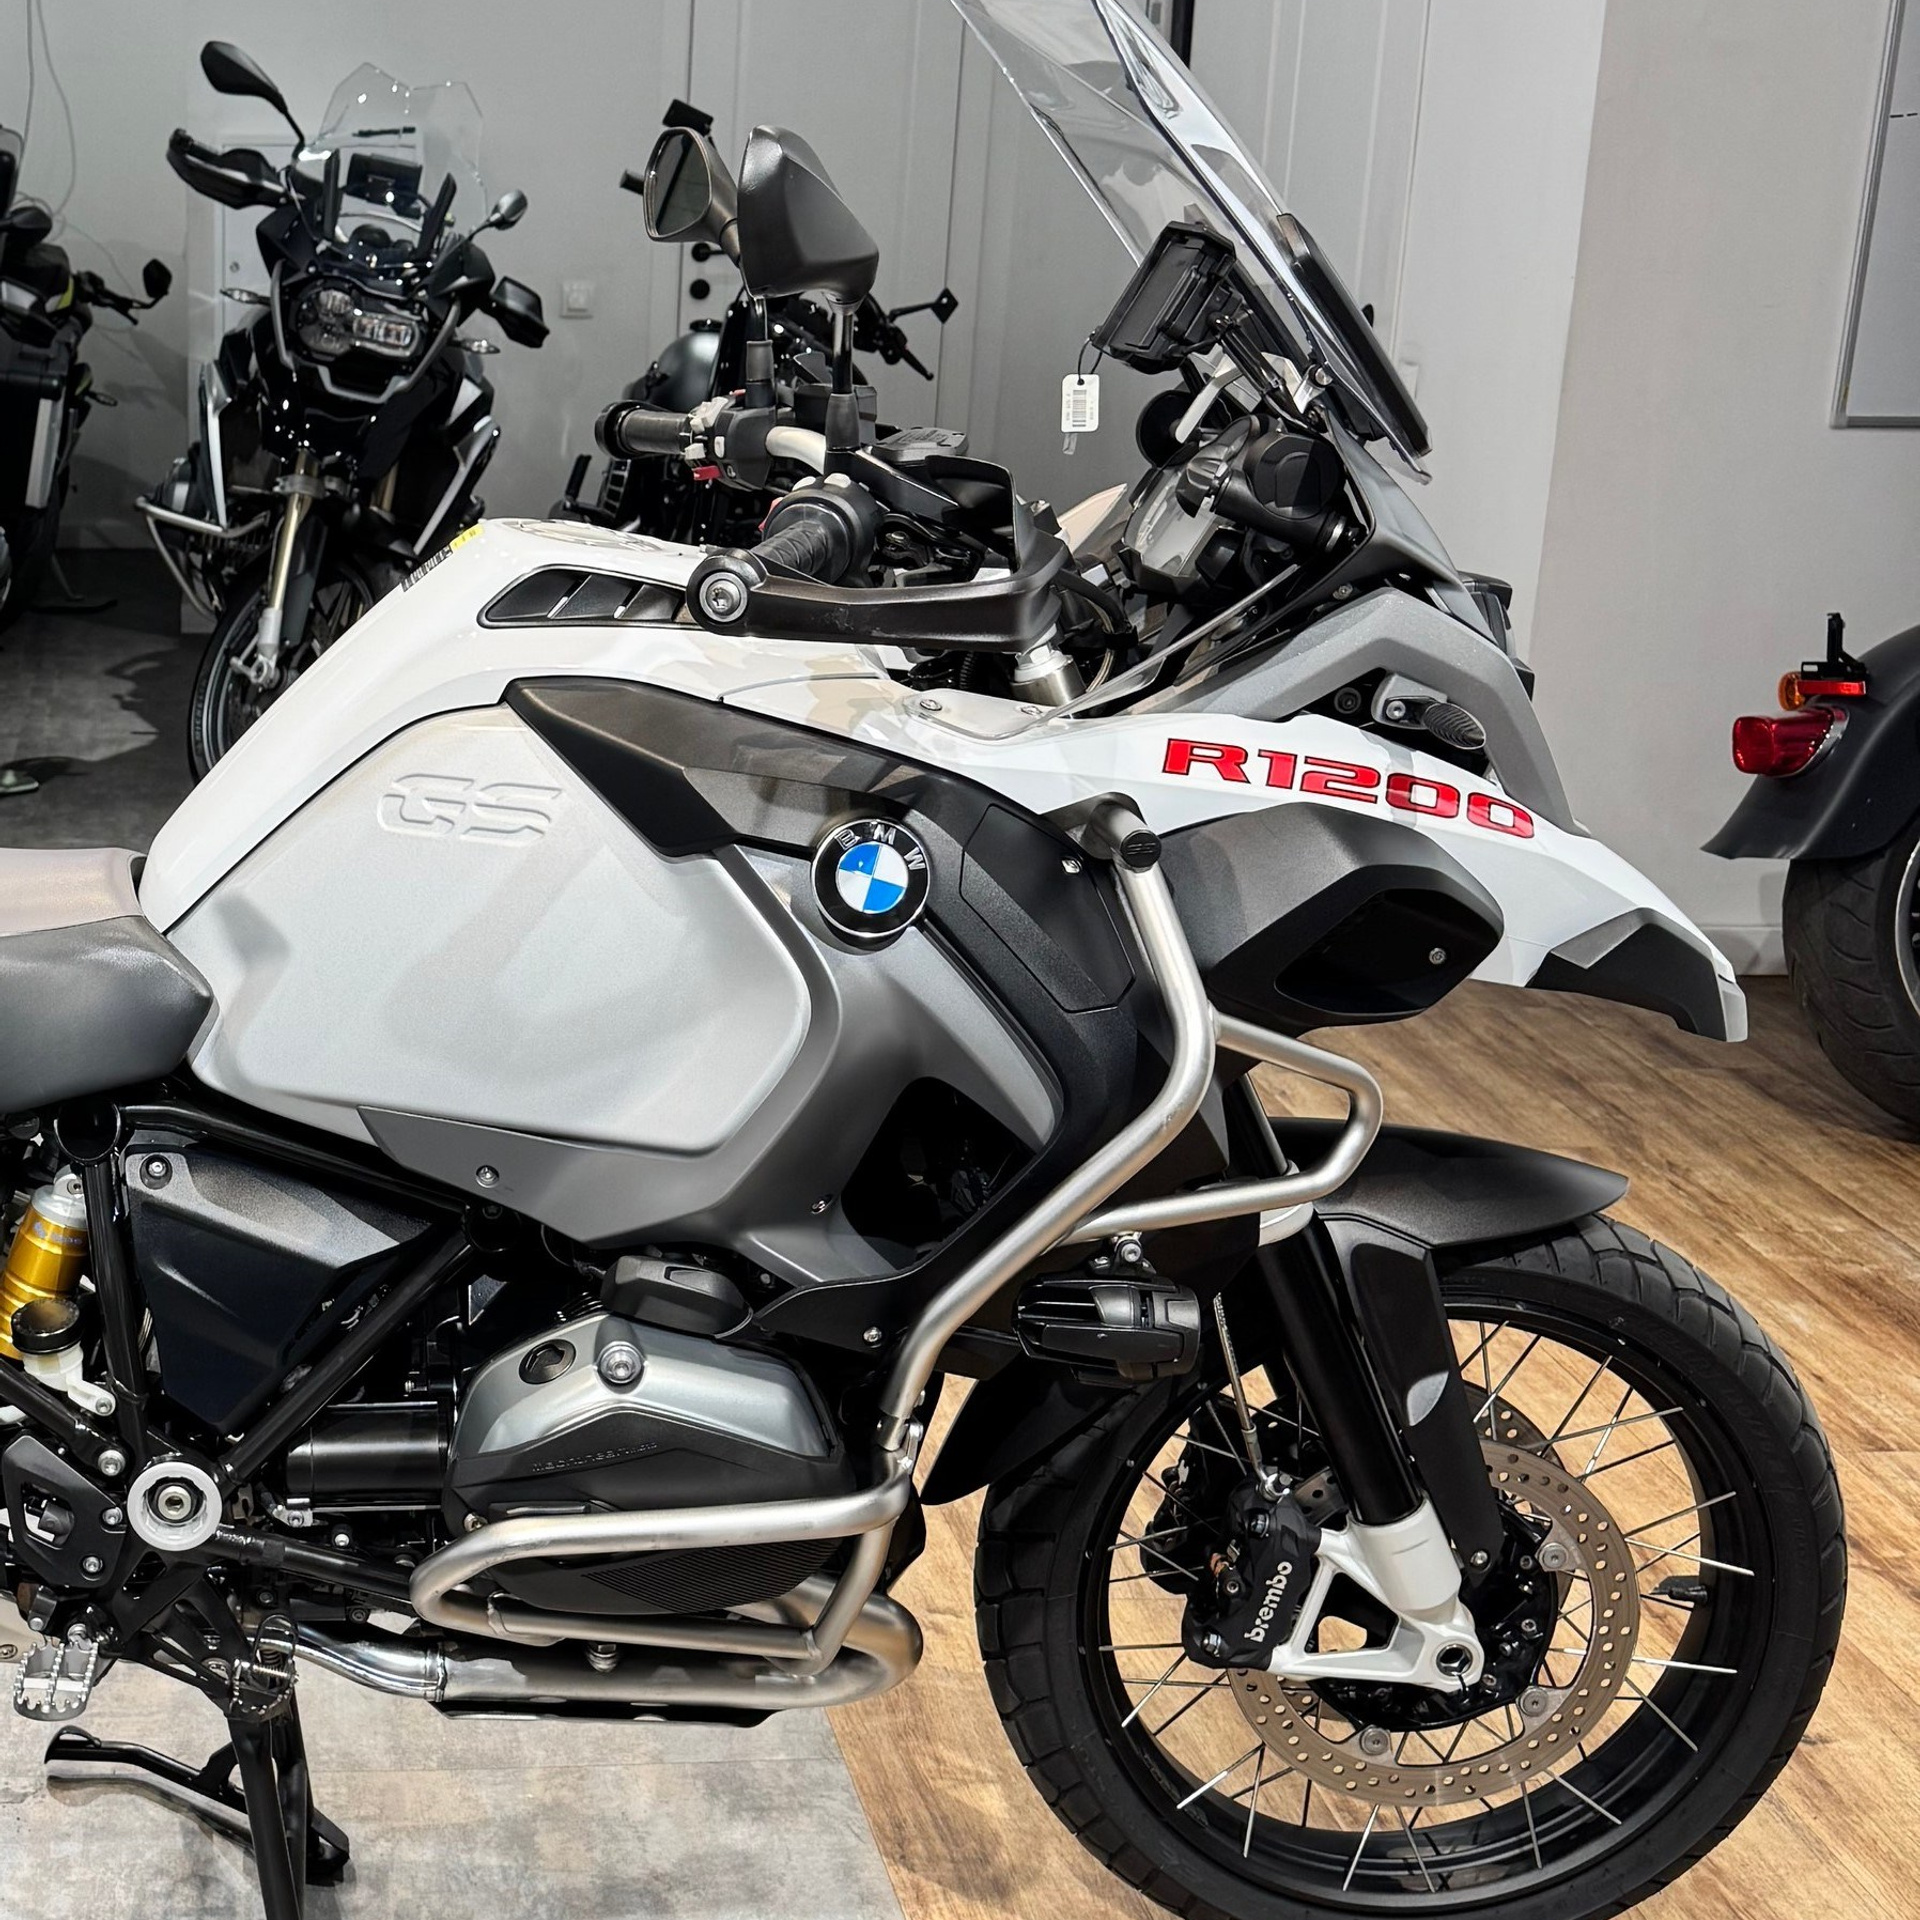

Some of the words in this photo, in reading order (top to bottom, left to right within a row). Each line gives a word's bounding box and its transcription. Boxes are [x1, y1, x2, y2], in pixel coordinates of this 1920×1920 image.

[377, 773, 564, 848] GS
[1161, 737, 1535, 839] R1200
[834, 823, 927, 871] BMW
[1243, 1561, 1293, 1643] brembo
